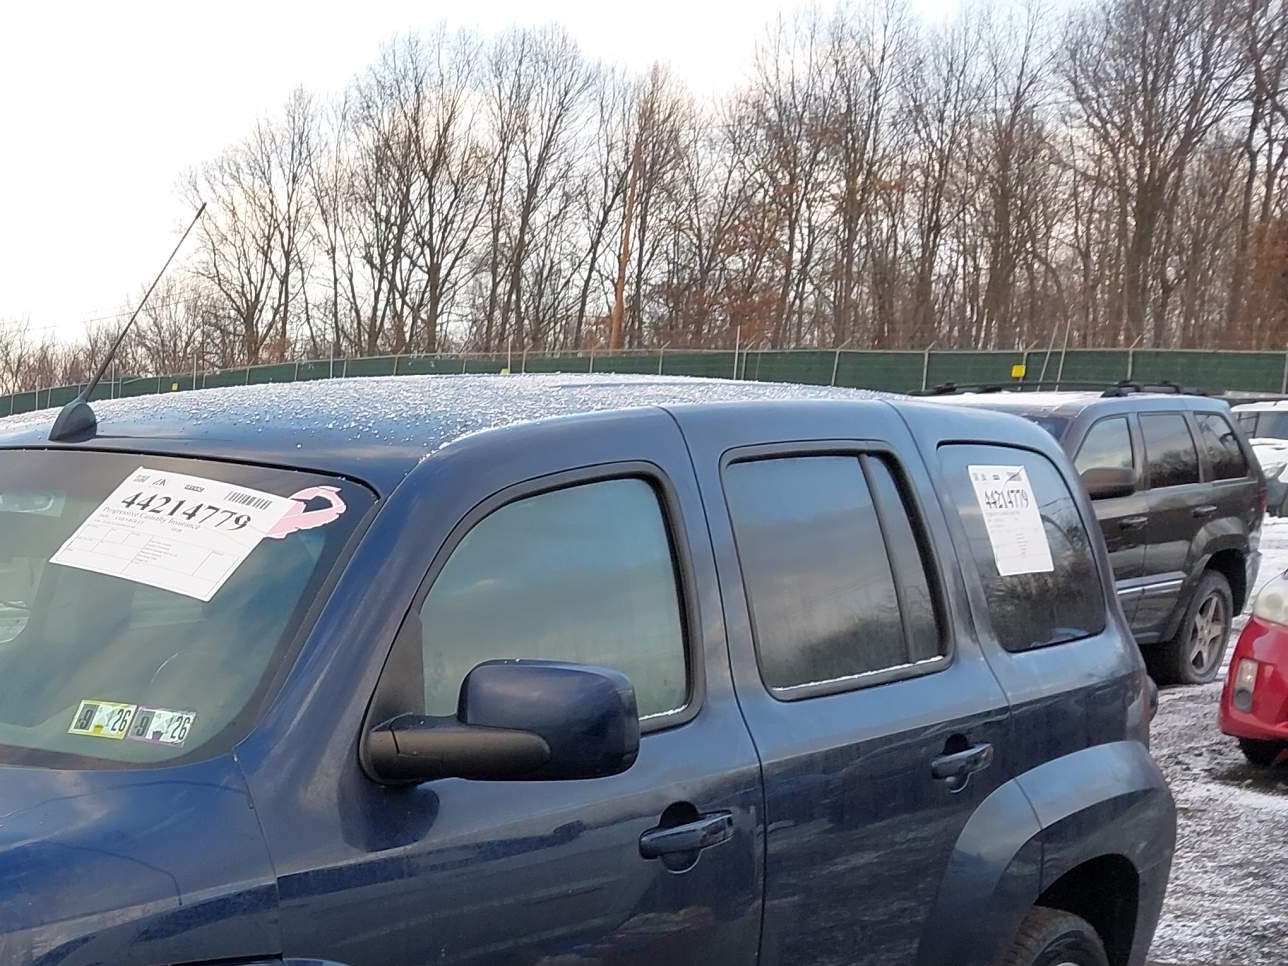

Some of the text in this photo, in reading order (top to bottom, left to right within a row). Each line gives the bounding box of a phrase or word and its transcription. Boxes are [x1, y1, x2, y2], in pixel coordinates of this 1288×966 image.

[984, 488, 1030, 509] 44214779
[121, 491, 252, 531] 44214779
[111, 708, 131, 732] 26
[170, 715, 191, 740] 26
